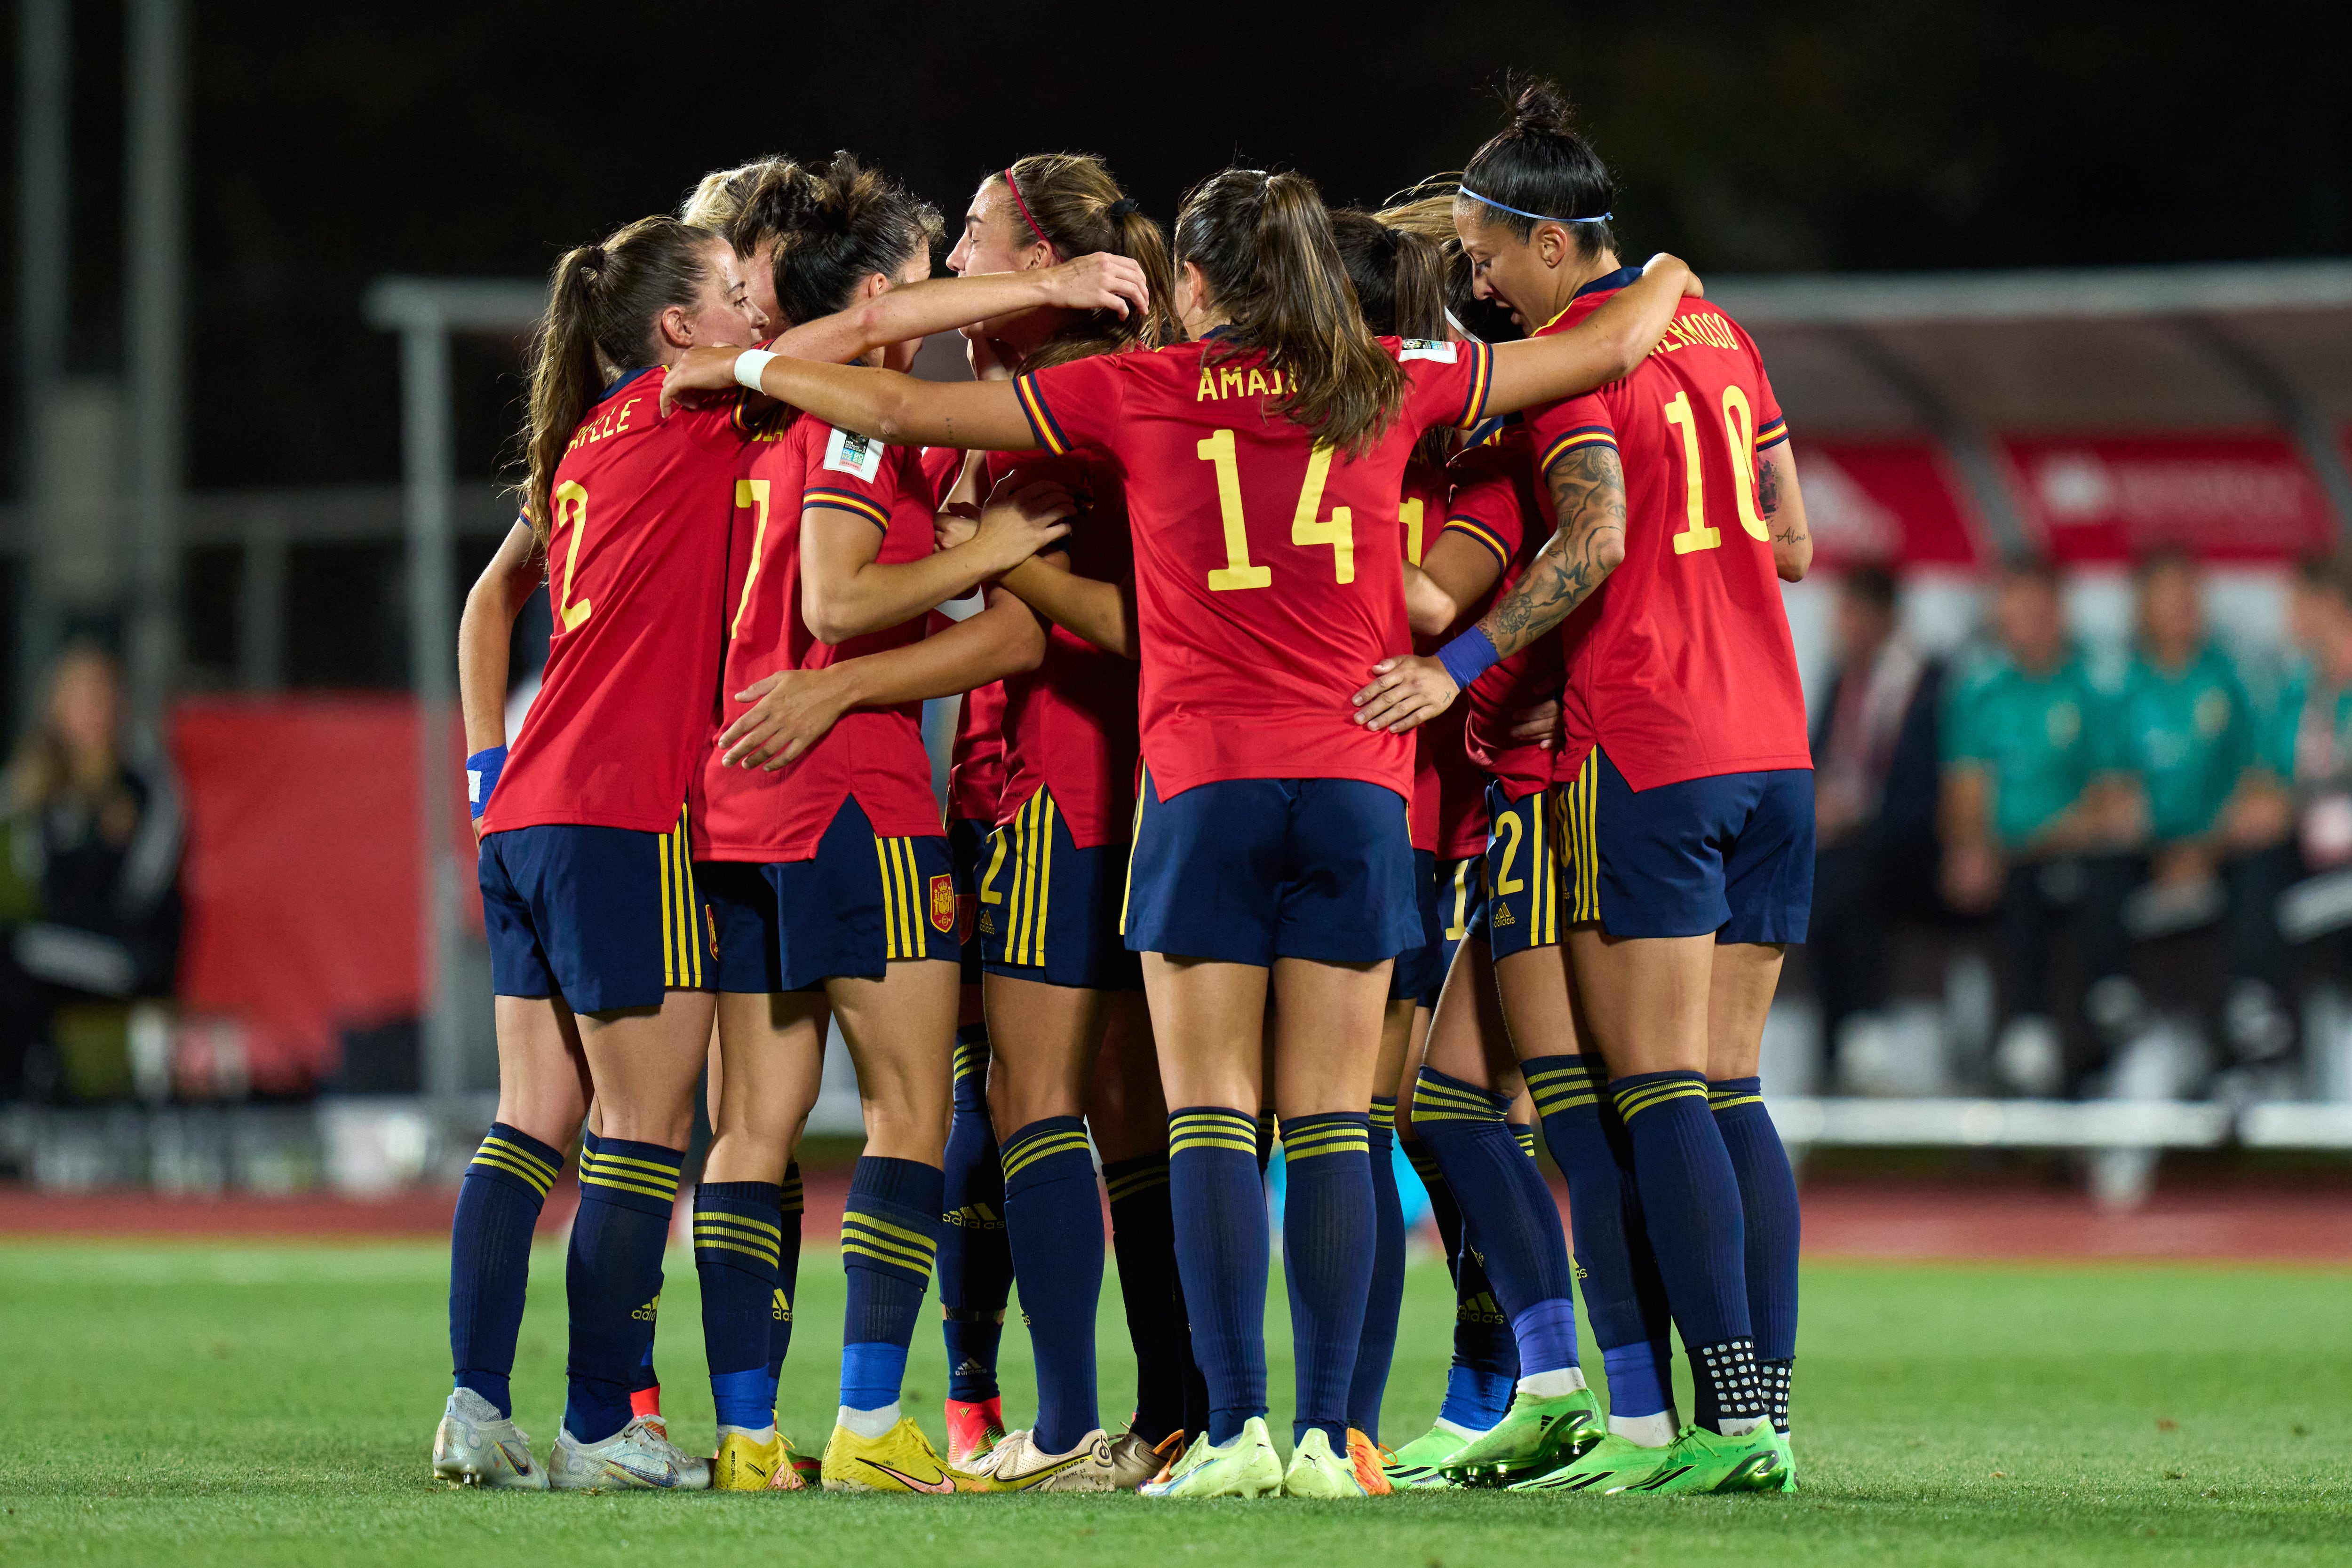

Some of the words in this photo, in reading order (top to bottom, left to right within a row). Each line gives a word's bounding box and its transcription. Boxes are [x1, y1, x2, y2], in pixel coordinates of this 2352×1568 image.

[558, 397, 642, 467] ATLLE
[1664, 385, 1770, 554] 10
[1197, 429, 1355, 591] 14
[556, 480, 591, 632] 2
[731, 479, 771, 639] 7
[977, 826, 1007, 905] 2
[1489, 811, 1524, 900] 2
[1494, 916, 1515, 928] adidas
[943, 1213, 1005, 1229] adidas
[631, 1309, 657, 1322] adid
[772, 1308, 793, 1323] das
[955, 1367, 988, 1377] adidas
